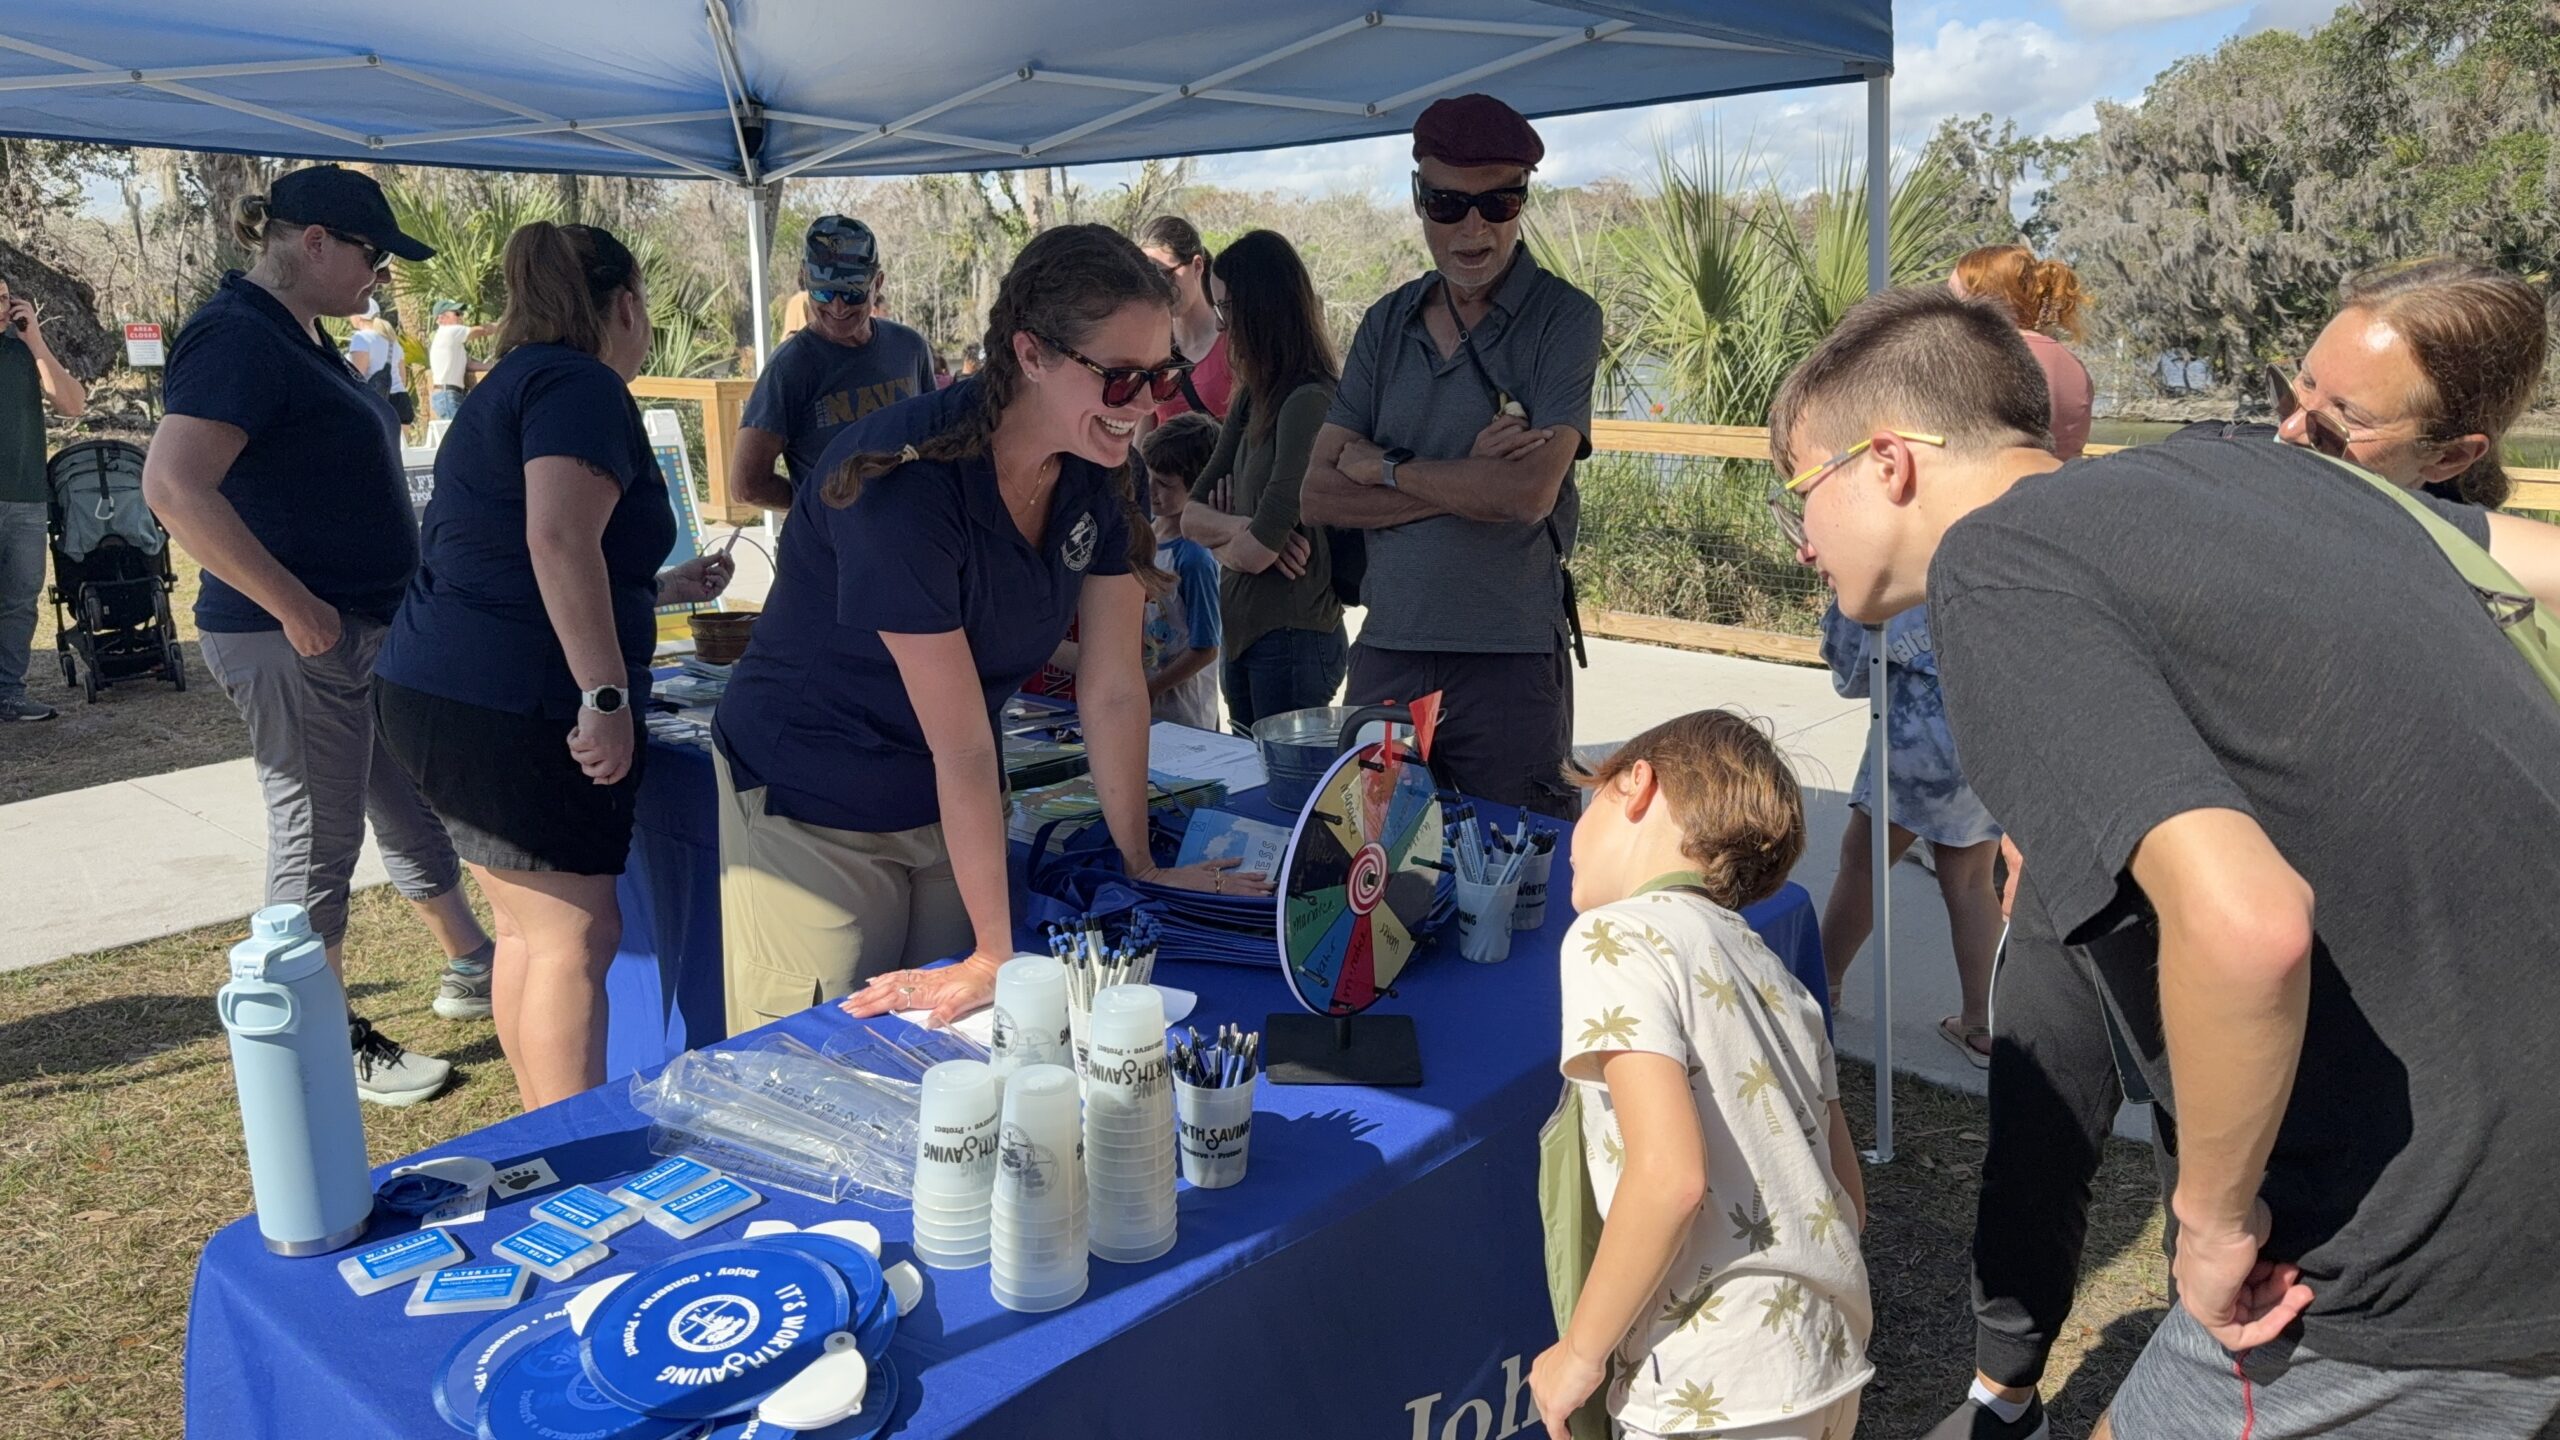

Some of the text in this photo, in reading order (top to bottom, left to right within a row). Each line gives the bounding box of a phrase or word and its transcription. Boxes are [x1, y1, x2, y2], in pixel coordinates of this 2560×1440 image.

[823, 376, 916, 427] NAVY
[924, 1135, 978, 1163] SAVING
[623, 1267, 760, 1357] Enjoy Conserve Protect
[775, 1283, 808, 1312] IT'S
[736, 1314, 807, 1368] WORTH
[656, 1352, 745, 1386] SAVING
[1405, 1354, 1543, 1440] Joh
